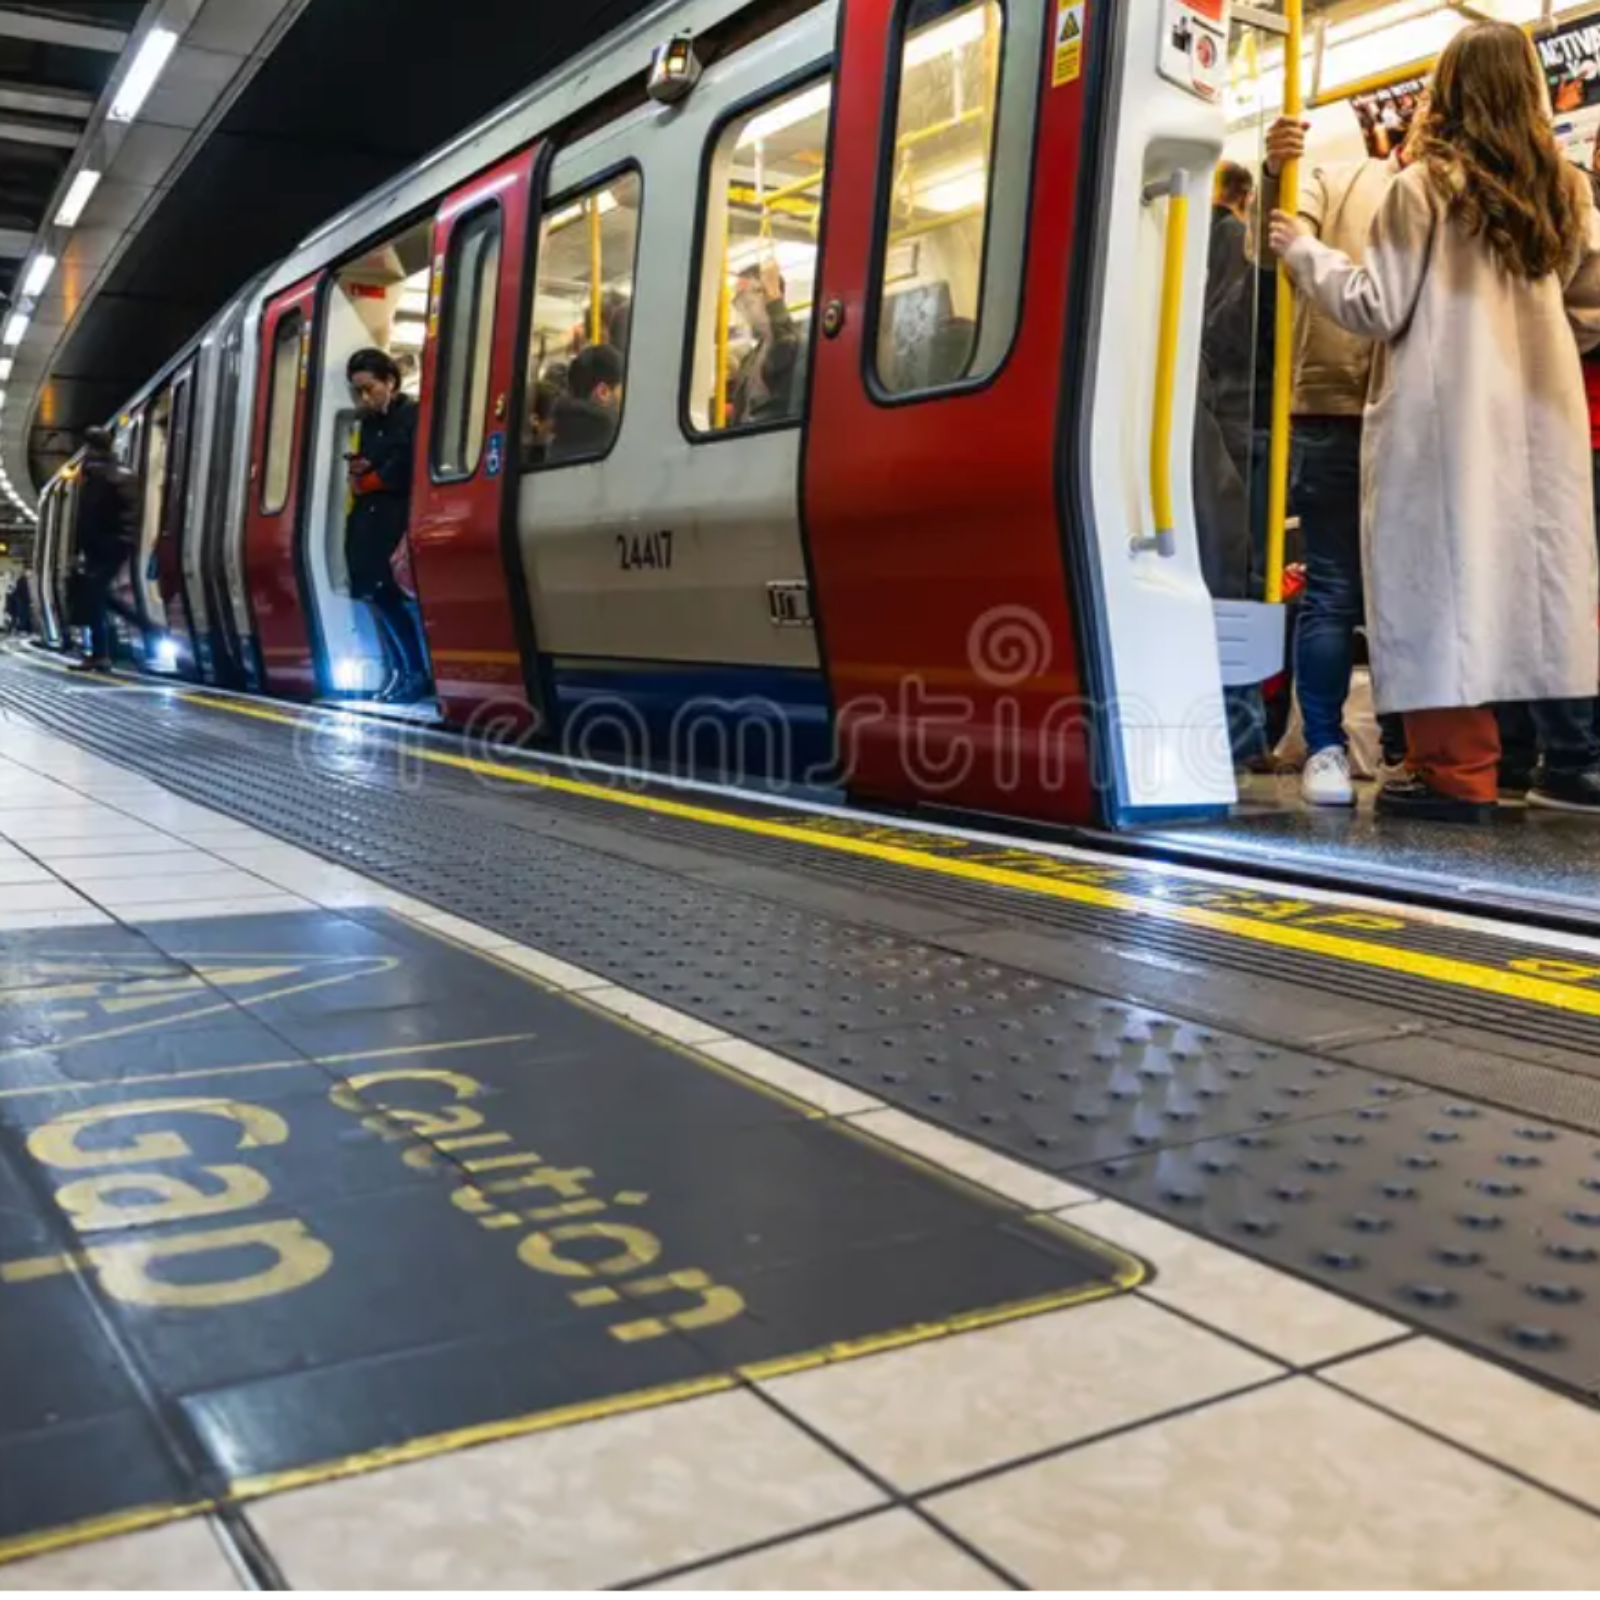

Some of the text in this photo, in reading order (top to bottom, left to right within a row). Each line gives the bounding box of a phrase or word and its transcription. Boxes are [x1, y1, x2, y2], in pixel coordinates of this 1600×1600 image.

[616, 530, 673, 570] 24417
[0, 1098, 333, 1307] Gap
[329, 1069, 746, 1342] Caution
